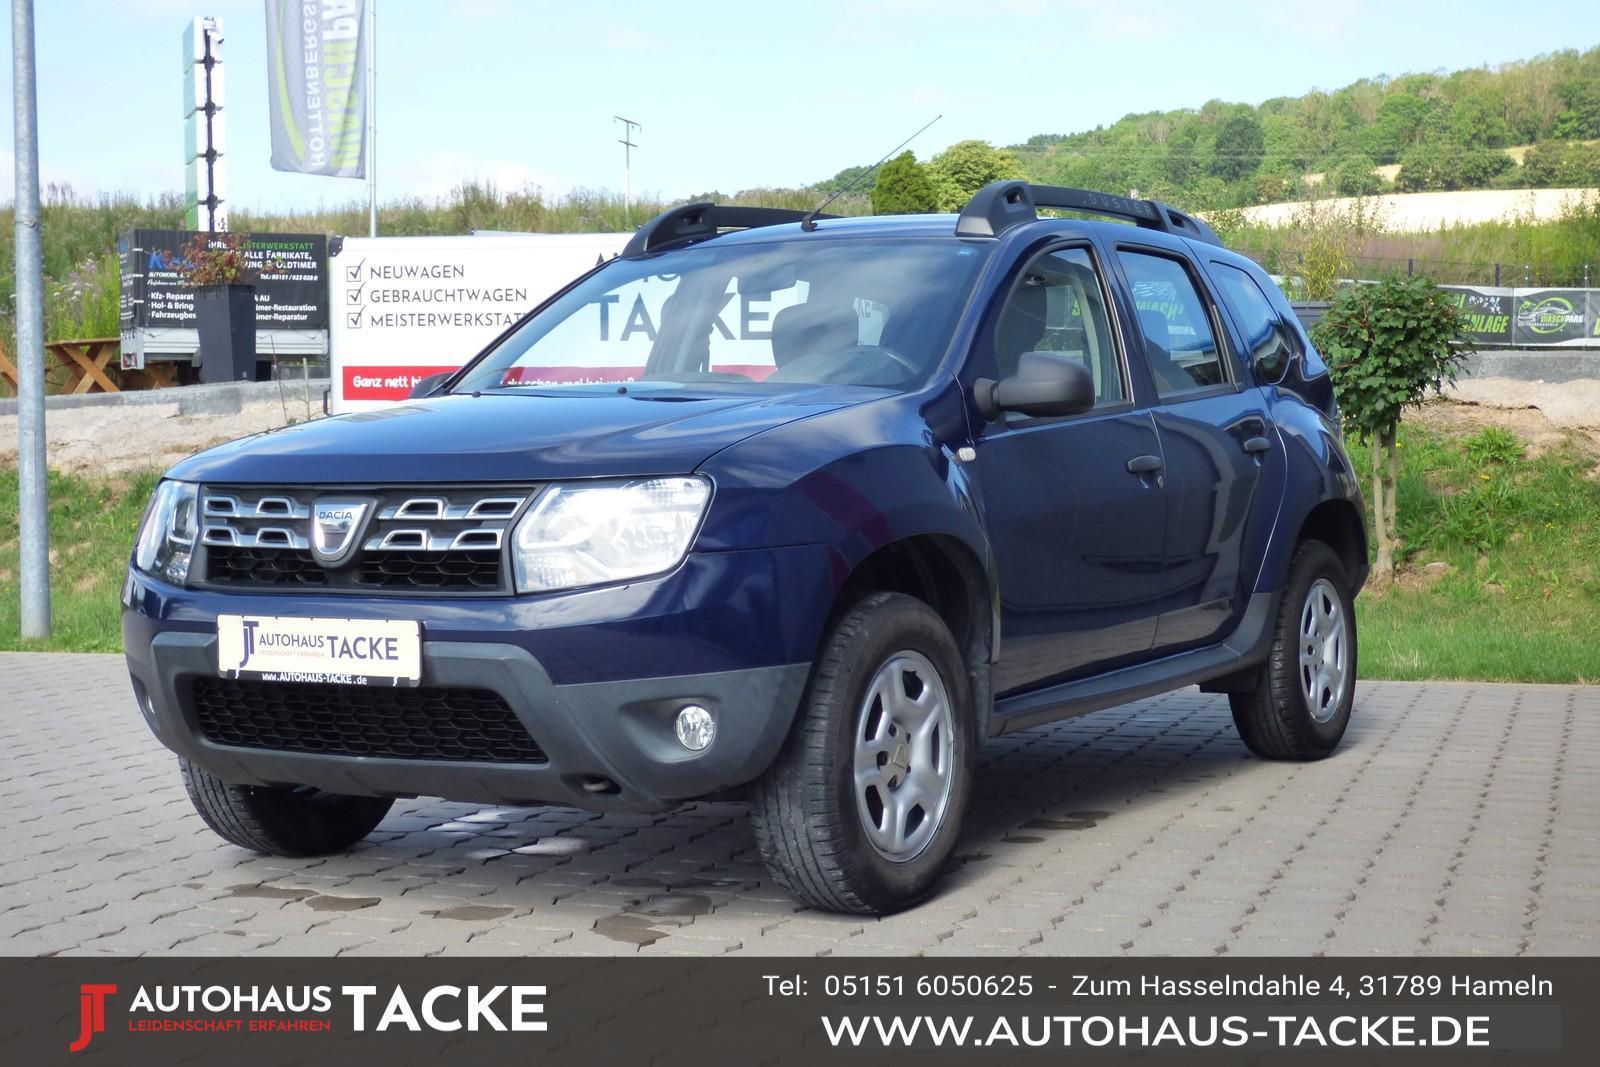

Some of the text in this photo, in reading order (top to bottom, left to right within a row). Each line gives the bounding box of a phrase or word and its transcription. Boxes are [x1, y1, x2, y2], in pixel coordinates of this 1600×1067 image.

[244, 251, 264, 259] ALLE
[370, 265, 464, 279] NEUWAGEN
[166, 292, 194, 301] Reparat
[370, 288, 527, 303] GEBRAUCHTWAGEN
[151, 311, 197, 320] Fahrzeugbes
[256, 313, 308, 321] imer-Reparatur
[371, 312, 526, 327] MEISTERWERKSTAT
[600, 292, 772, 341] TAKE
[353, 375, 382, 388] Ganz
[385, 376, 408, 388] nett
[319, 511, 353, 520] DACIA
[259, 633, 325, 648] AUTOHAUS
[326, 635, 399, 661] TACKE
